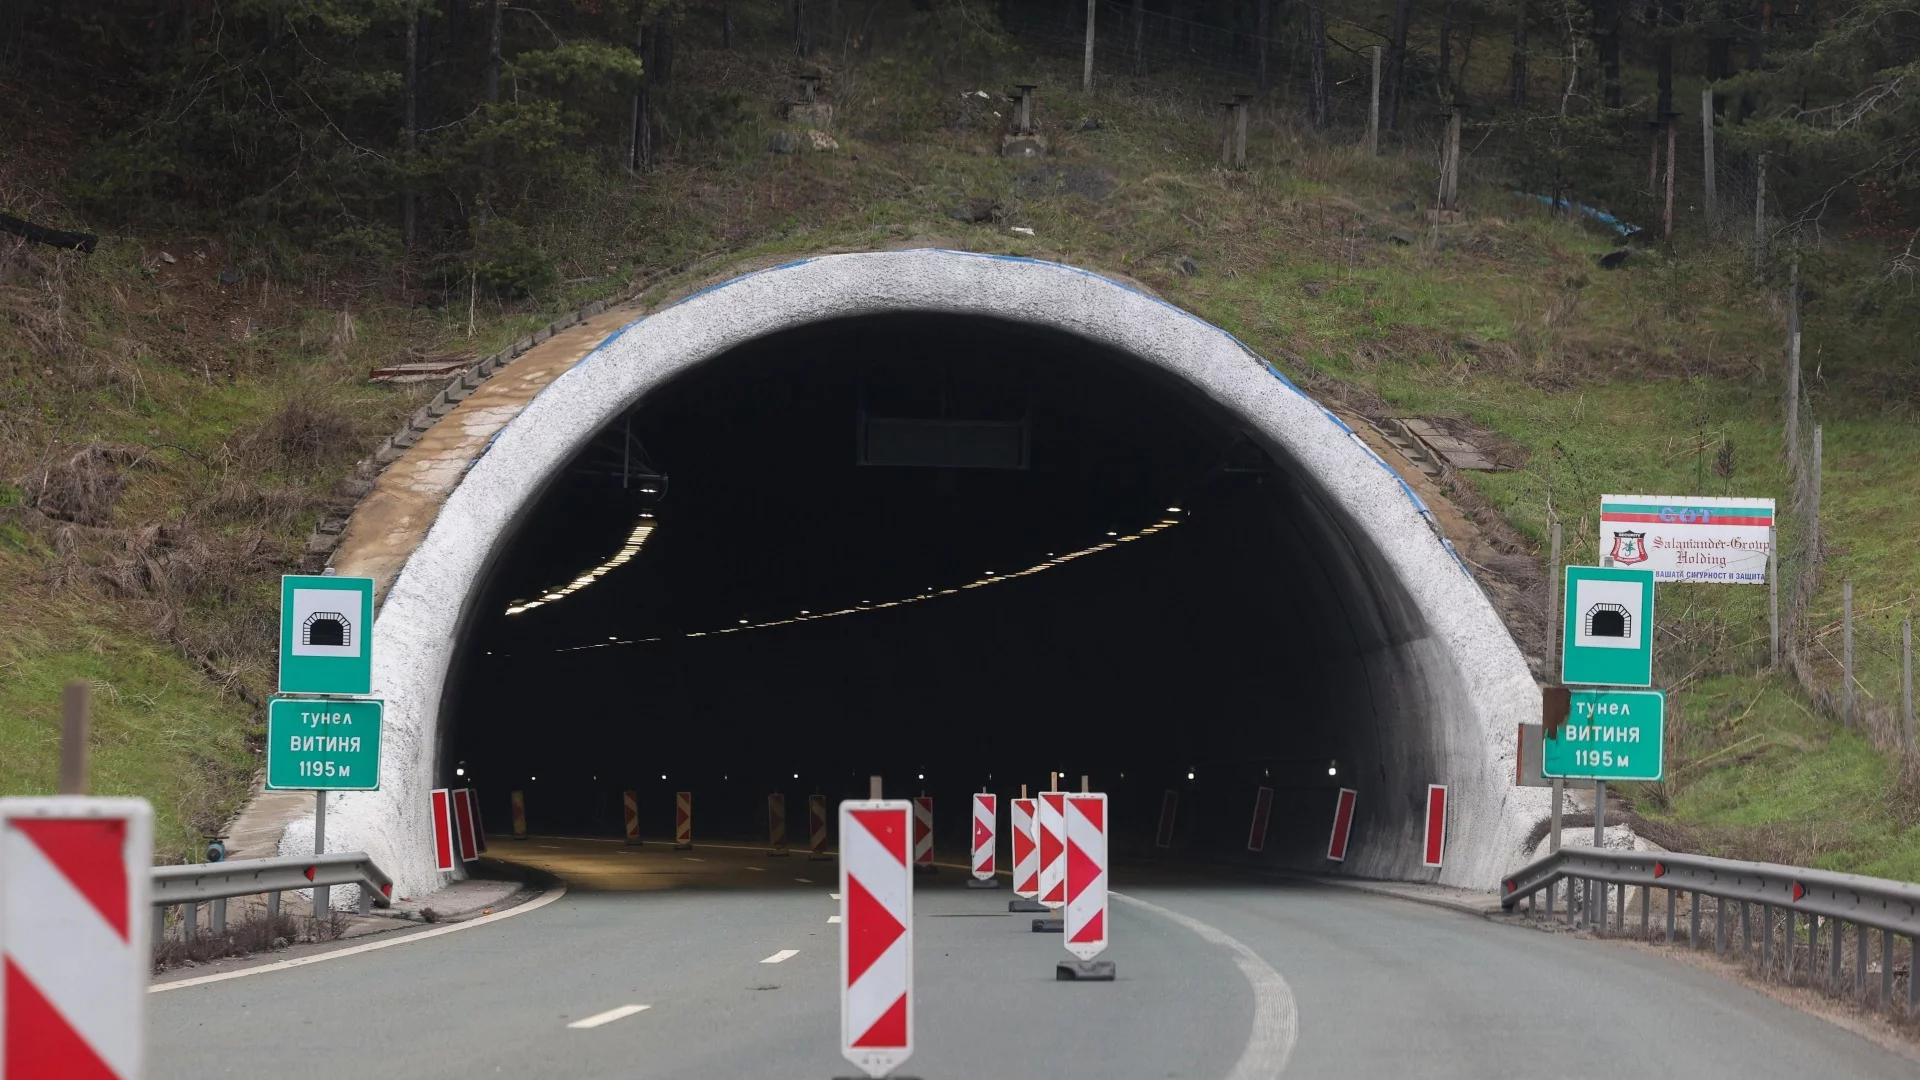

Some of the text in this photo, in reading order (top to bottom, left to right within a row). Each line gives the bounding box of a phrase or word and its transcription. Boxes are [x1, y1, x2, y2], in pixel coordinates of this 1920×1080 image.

[1652, 536, 1770, 552] Salamander-Group
[1676, 550, 1727, 568] Holding
[1655, 570, 1685, 578] ВАШАТА
[1686, 571, 1726, 580] СИГУРНОСТ
[1576, 702, 1630, 718] тунел
[301, 712, 352, 728] тунел
[1565, 725, 1640, 743] ВИТИНЯ
[290, 735, 360, 752] ВИТИНЯ
[1576, 749, 1629, 767] 1195 м
[299, 761, 350, 777] 1195 м
